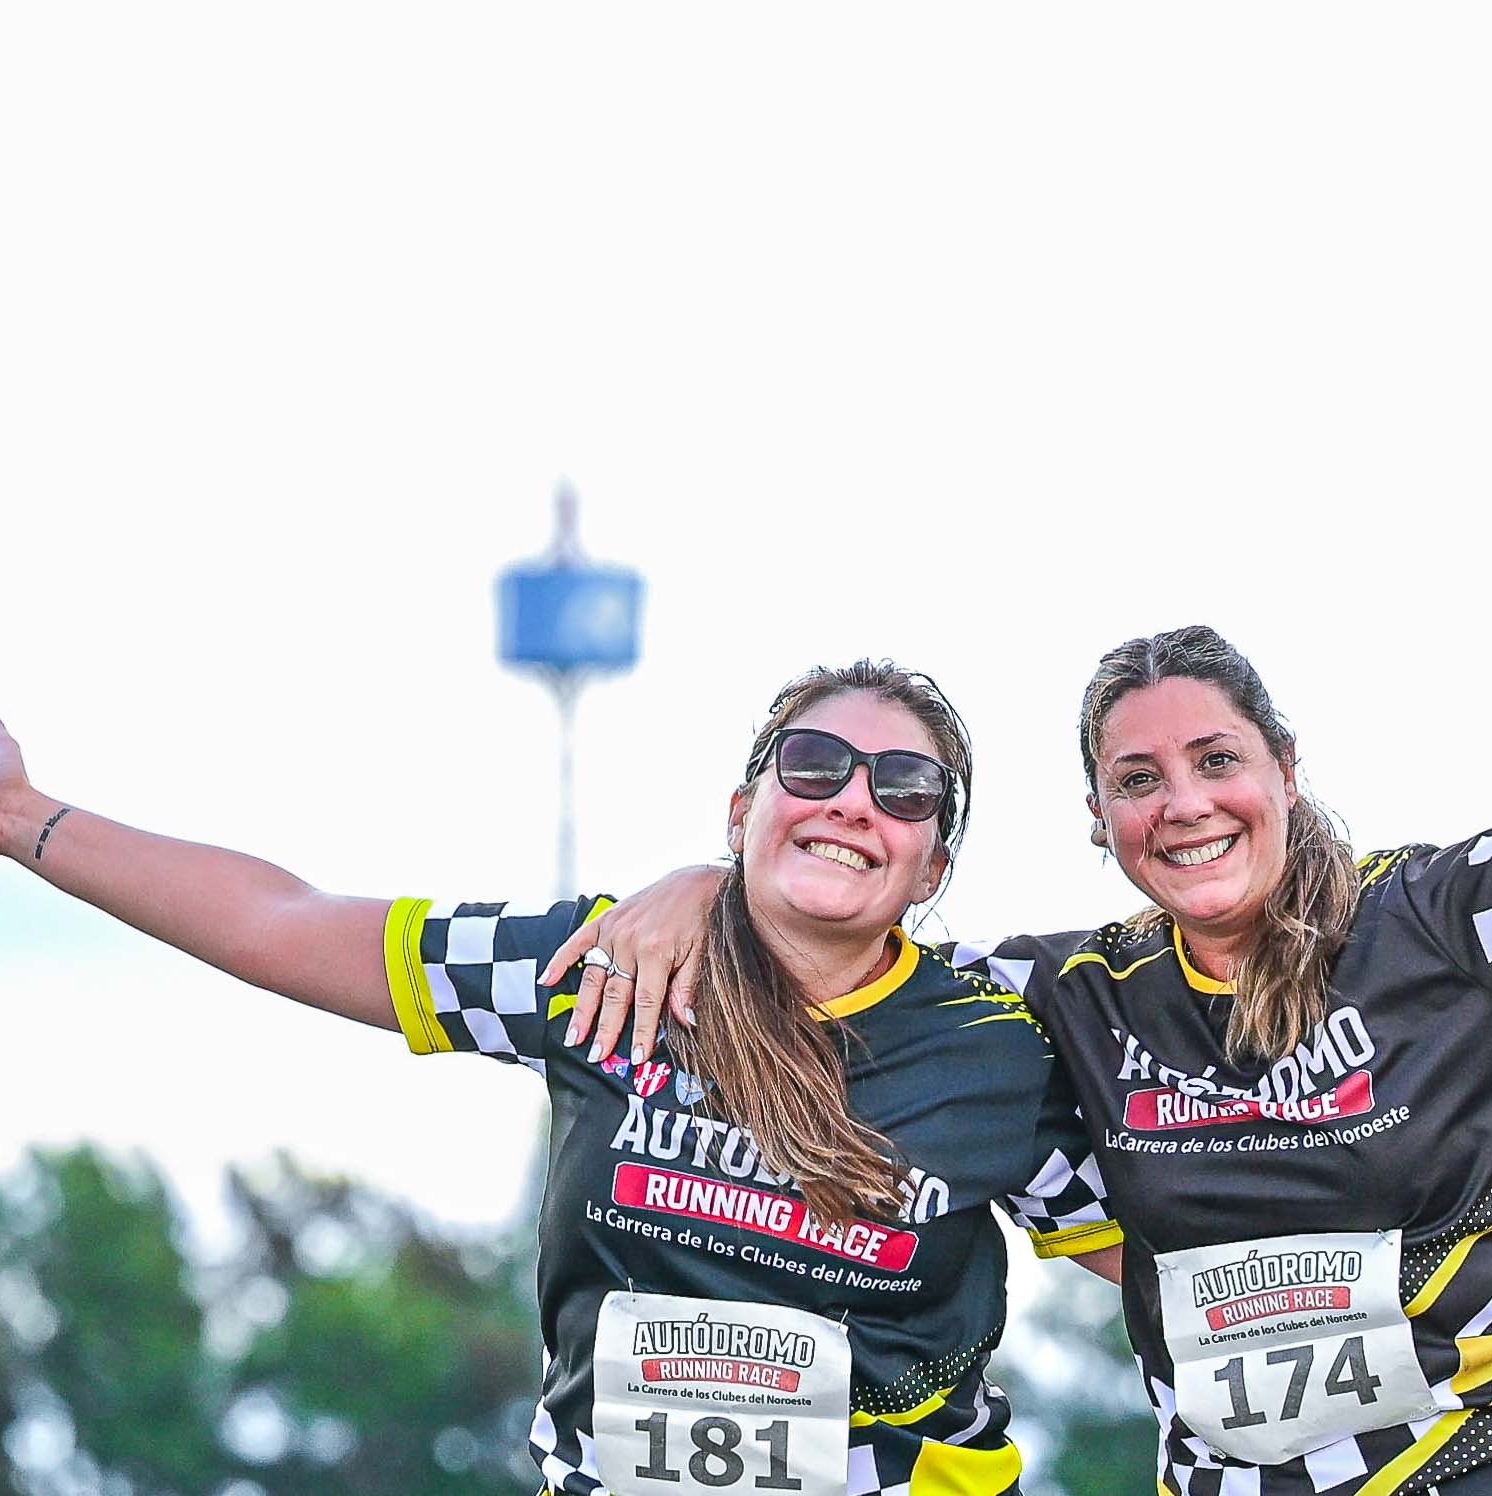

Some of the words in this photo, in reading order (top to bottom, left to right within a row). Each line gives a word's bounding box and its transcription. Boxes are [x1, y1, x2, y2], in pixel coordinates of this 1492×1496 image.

[1118, 1132, 1176, 1154] Carrera
[1181, 1138, 1204, 1153] de
[1207, 1138, 1234, 1153] los
[1237, 1133, 1298, 1152] Clubes
[586, 1200, 603, 1223] La
[605, 1208, 672, 1242] Carrera
[677, 1229, 702, 1249] de
[707, 1235, 735, 1257] los
[740, 1245, 807, 1276] Clubes
[811, 1264, 844, 1284] del
[846, 1271, 923, 1292] Noroeste
[644, 1173, 793, 1232] RUNNING
[797, 1207, 888, 1264] RACE
[1192, 1250, 1362, 1308] AUTÓDROMO
[1198, 1336, 1210, 1346] La
[1211, 1331, 1247, 1344] Carrera
[1248, 1327, 1261, 1338] de
[1261, 1325, 1277, 1335] los
[1277, 1319, 1308, 1333] Clubes
[1310, 1315, 1325, 1328] del
[1326, 1311, 1368, 1325] Noroeste
[1222, 1291, 1290, 1325] RUNNING
[1293, 1289, 1334, 1309] RACE
[633, 1313, 815, 1368] AUTÓDROMO
[627, 1382, 640, 1393] La
[642, 1384, 678, 1397] Carrera
[680, 1387, 693, 1399] de
[695, 1388, 710, 1400] los
[712, 1390, 747, 1403] Clubes
[748, 1393, 765, 1405] del
[766, 1395, 812, 1406] Noroeste
[660, 1361, 733, 1380] RUNNING
[738, 1363, 782, 1388] RACE
[1214, 1335, 1382, 1430] 174
[634, 1411, 802, 1491] 181
